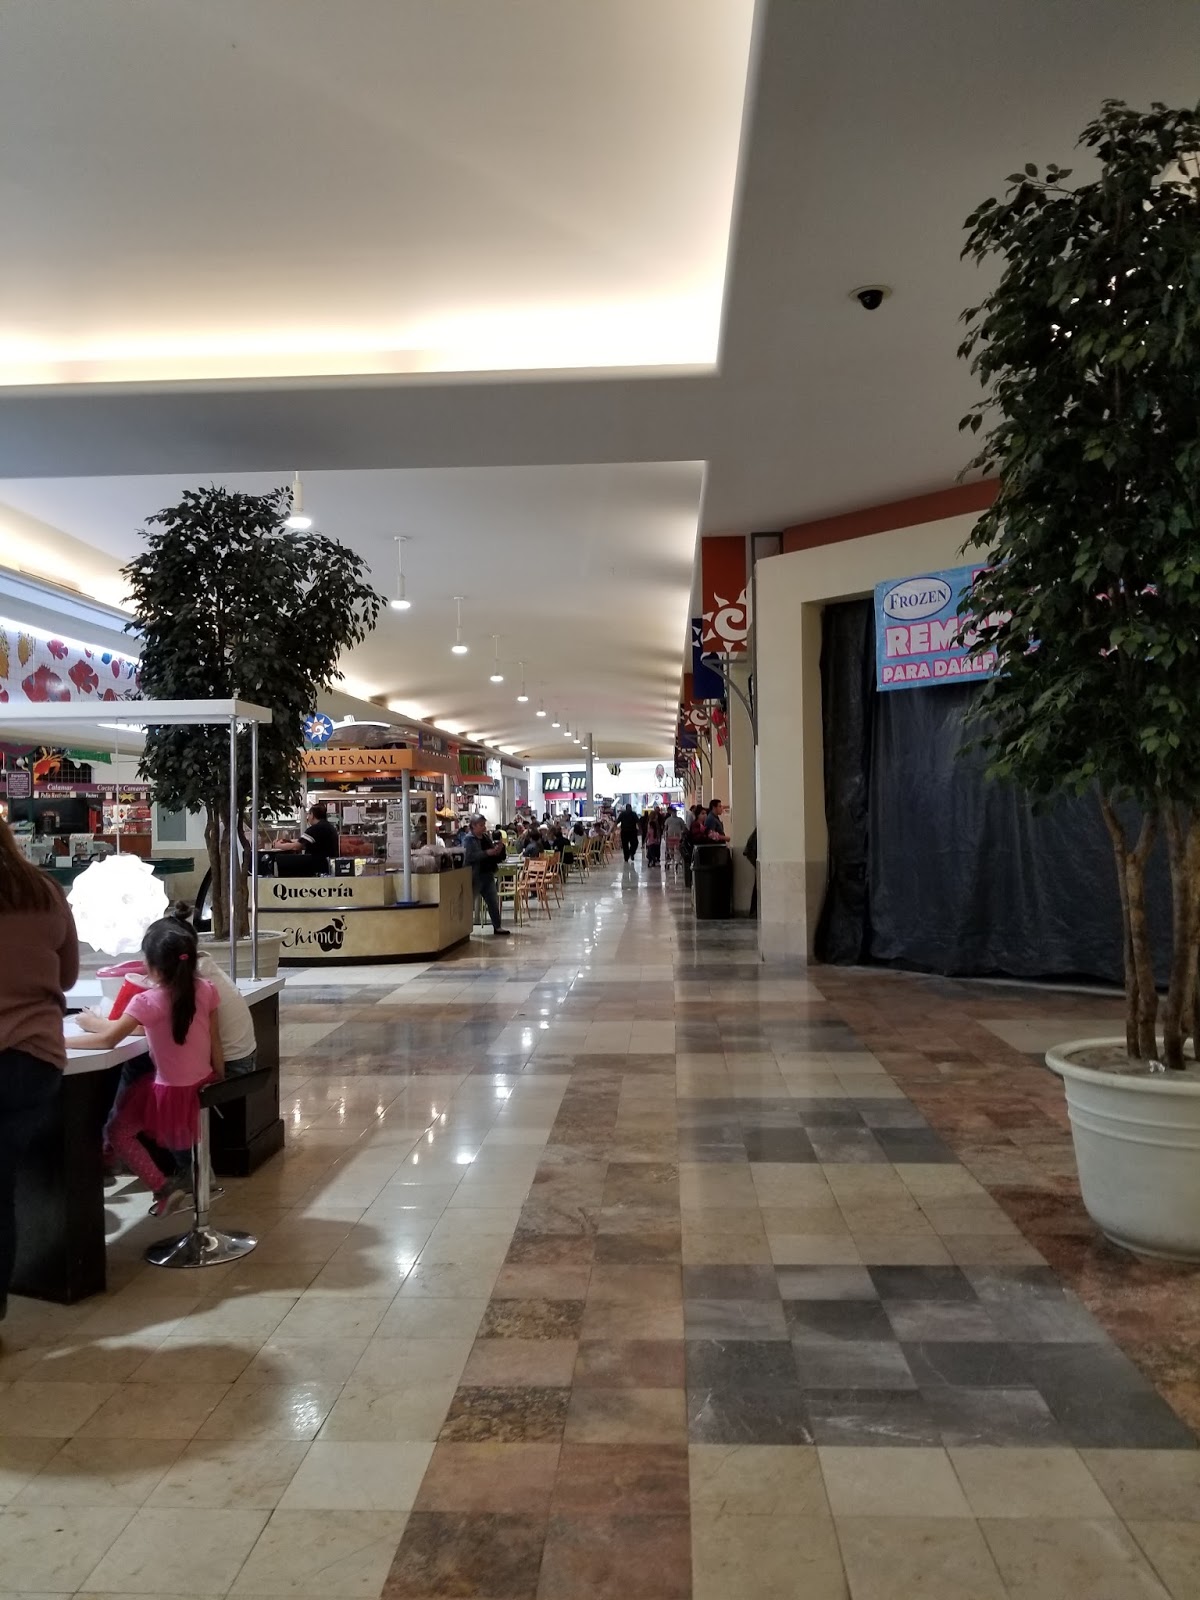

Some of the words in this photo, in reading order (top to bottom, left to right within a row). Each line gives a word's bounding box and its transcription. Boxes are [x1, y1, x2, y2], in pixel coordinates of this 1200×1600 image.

[890, 588, 947, 610] FROZEN
[883, 662, 931, 684] PARA
[308, 755, 397, 767] ARTESANAL
[273, 883, 354, 901] Quesería
